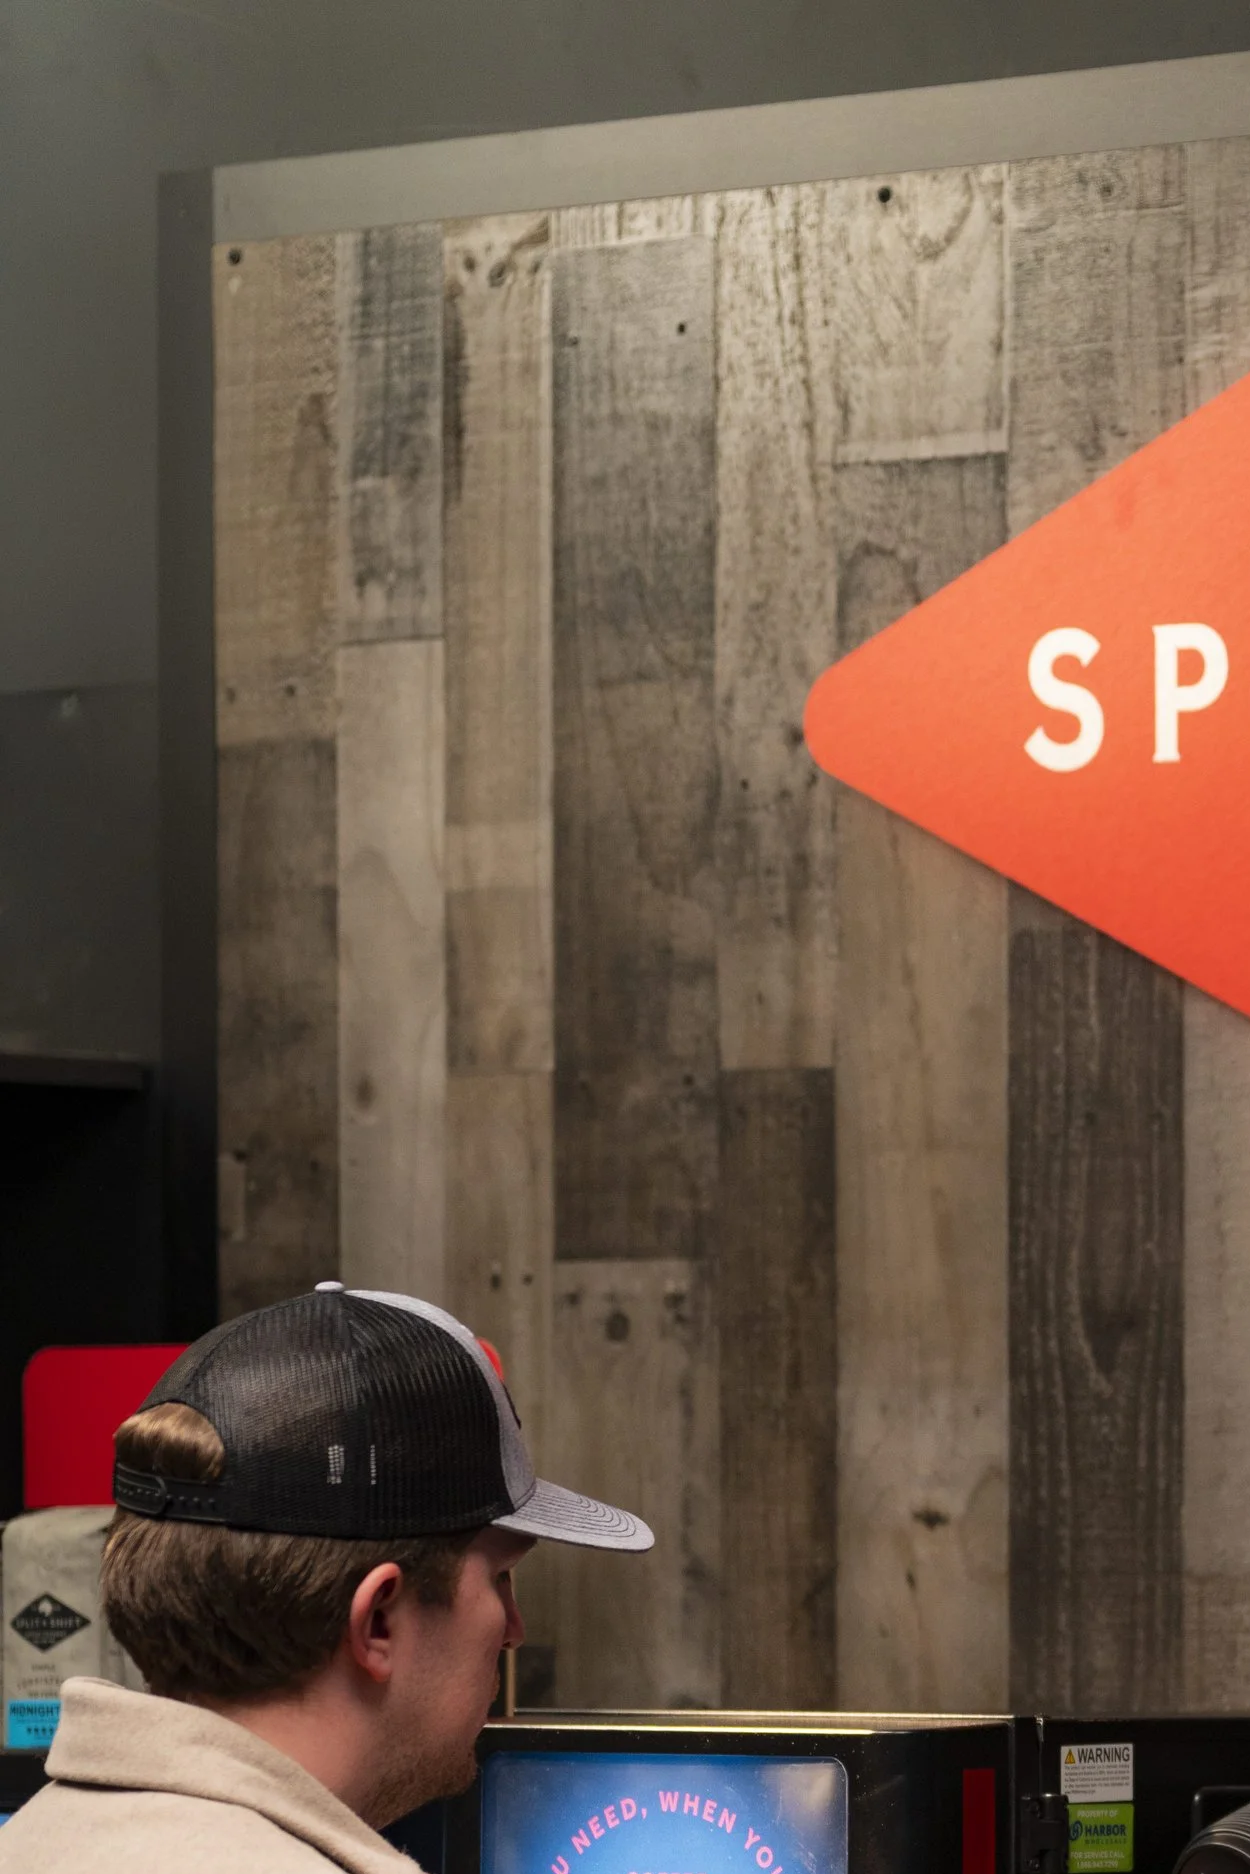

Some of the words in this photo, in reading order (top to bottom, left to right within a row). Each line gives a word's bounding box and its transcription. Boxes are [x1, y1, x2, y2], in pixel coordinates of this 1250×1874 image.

[1077, 1747, 1130, 1764] WARNING
[570, 1797, 648, 1856] NEED,
[658, 1791, 737, 1834] WHEN
[1085, 1824, 1127, 1836] HARBOR
